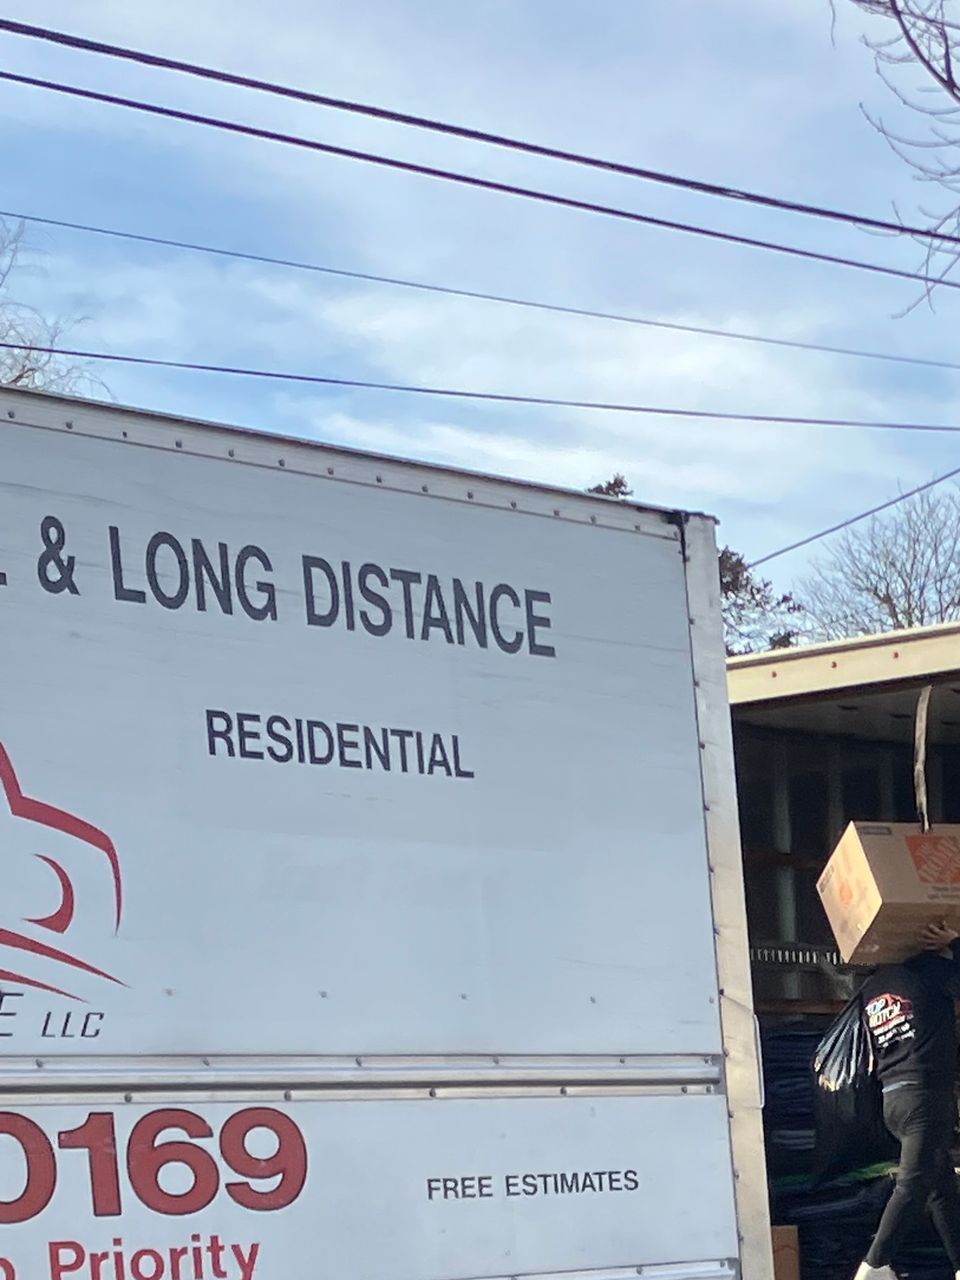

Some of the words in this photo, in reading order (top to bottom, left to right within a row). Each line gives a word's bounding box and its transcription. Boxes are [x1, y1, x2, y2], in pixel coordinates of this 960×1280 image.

[37, 515, 81, 596] &
[109, 525, 278, 622] LONG
[302, 554, 557, 658] DISTANCE
[205, 709, 475, 779] RESIDENTIAL
[41, 1011, 105, 1038] LLC
[426, 1175, 494, 1201] FREE
[505, 1169, 640, 1197] ESTIMATES
